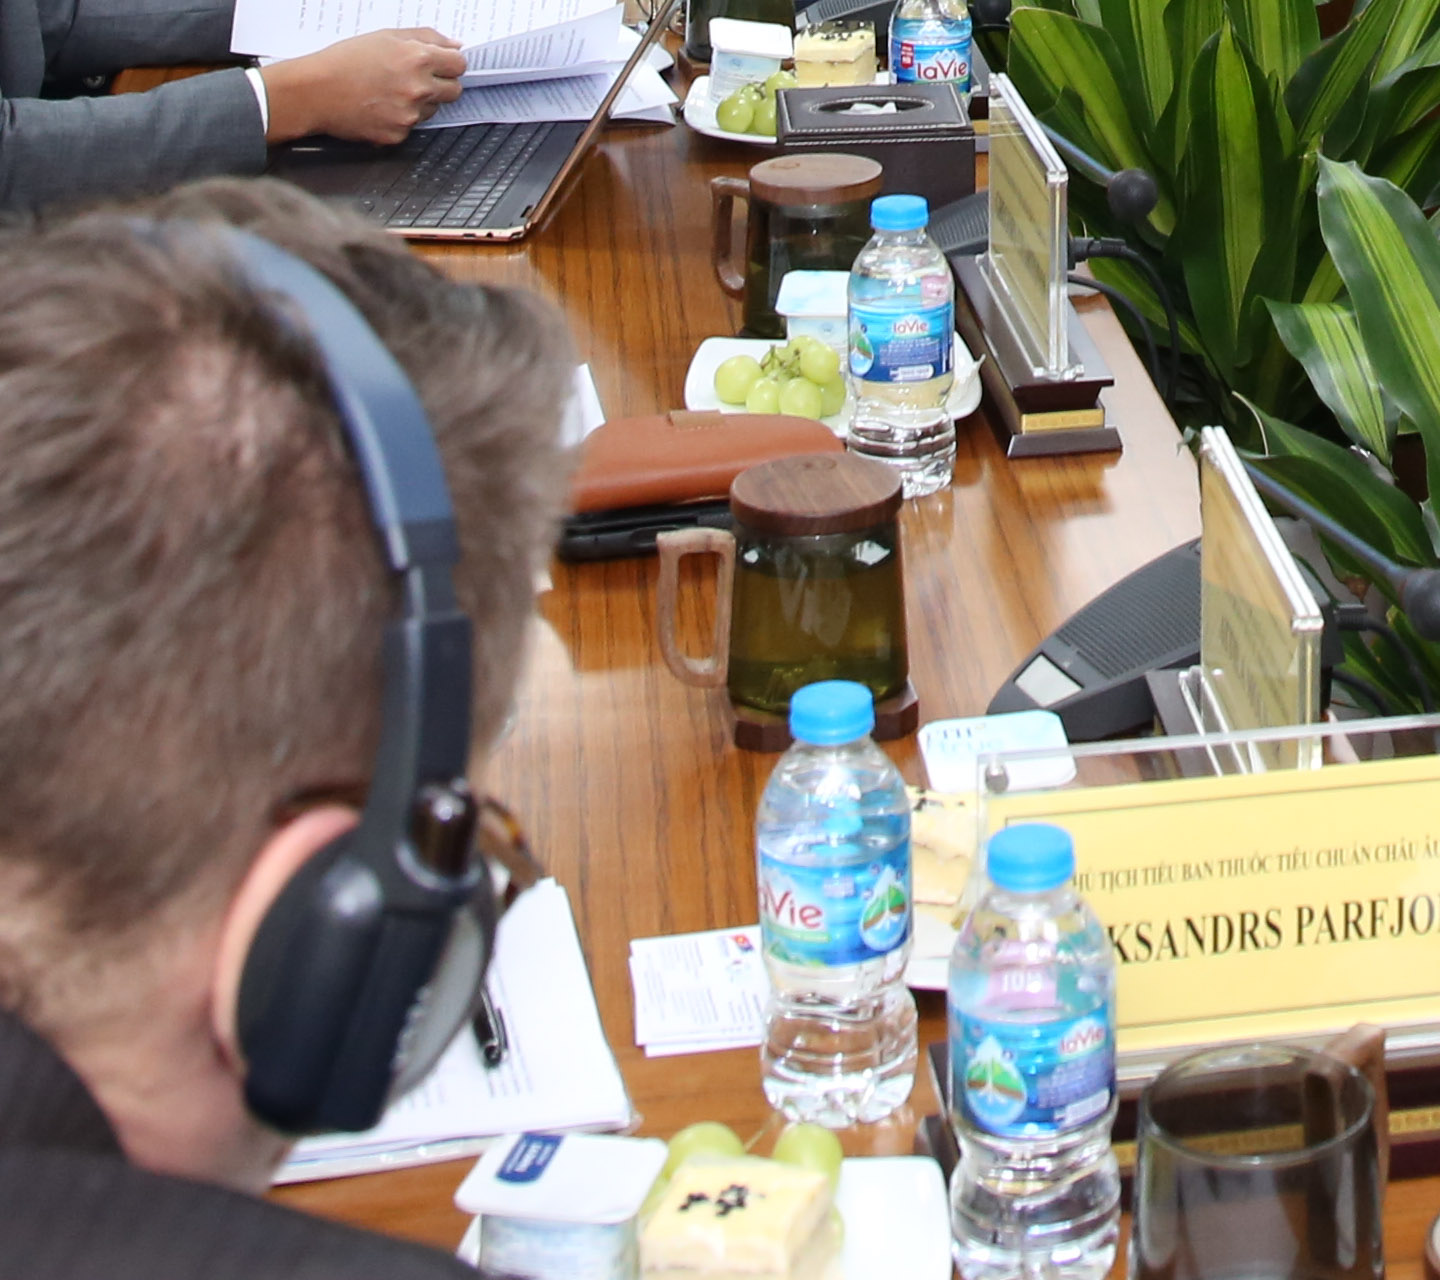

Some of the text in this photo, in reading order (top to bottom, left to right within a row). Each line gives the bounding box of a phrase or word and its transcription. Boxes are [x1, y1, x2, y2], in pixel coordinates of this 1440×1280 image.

[917, 59, 967, 80] laVie
[894, 319, 928, 334] laVie
[1099, 868, 1138, 894] TỊCH
[1181, 859, 1214, 883] BAN
[763, 890, 823, 930] Vie
[1106, 907, 1284, 966] KSANDRS
